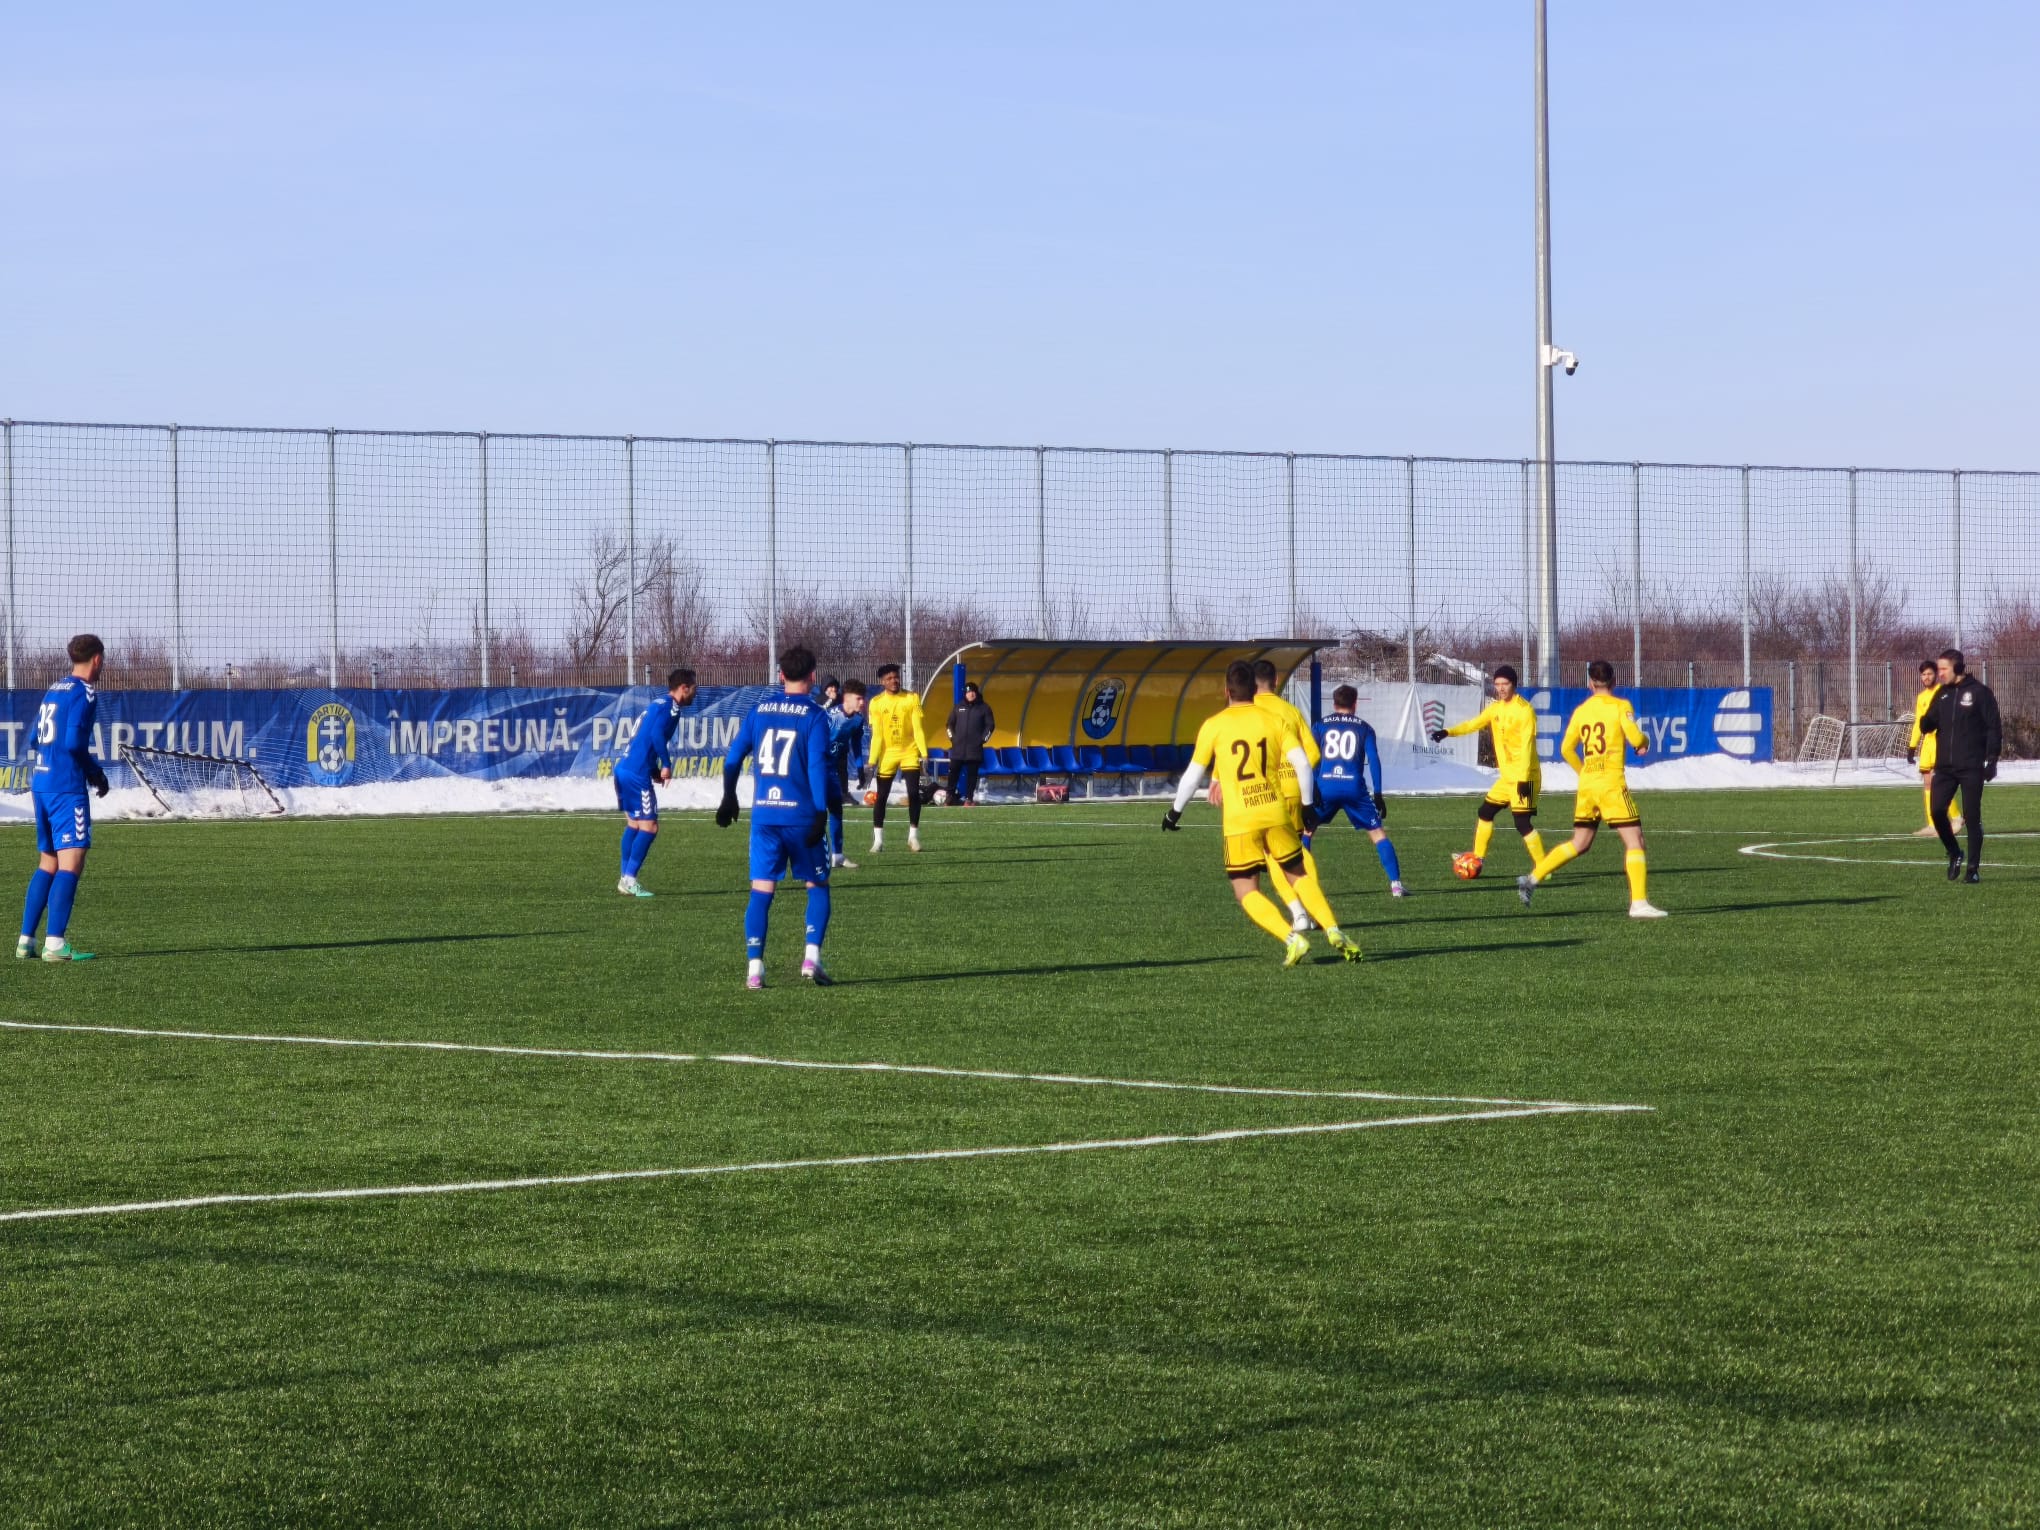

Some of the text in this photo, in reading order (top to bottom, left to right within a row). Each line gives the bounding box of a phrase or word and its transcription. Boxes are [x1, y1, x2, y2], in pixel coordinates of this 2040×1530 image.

[311, 704, 352, 724] PARTIUM
[780, 703, 808, 715] MARE
[88, 720, 257, 761] ARTIUM.
[387, 708, 580, 755] ÎMPREUNĂ.
[592, 715, 740, 751] PAIUM
[1324, 729, 1357, 760] 80
[1581, 721, 1606, 756] 23
[758, 728, 797, 776] 47
[1231, 737, 1267, 782] 21
[1241, 782, 1272, 796] ACADEMI
[1243, 791, 1278, 809] PARTIUM
